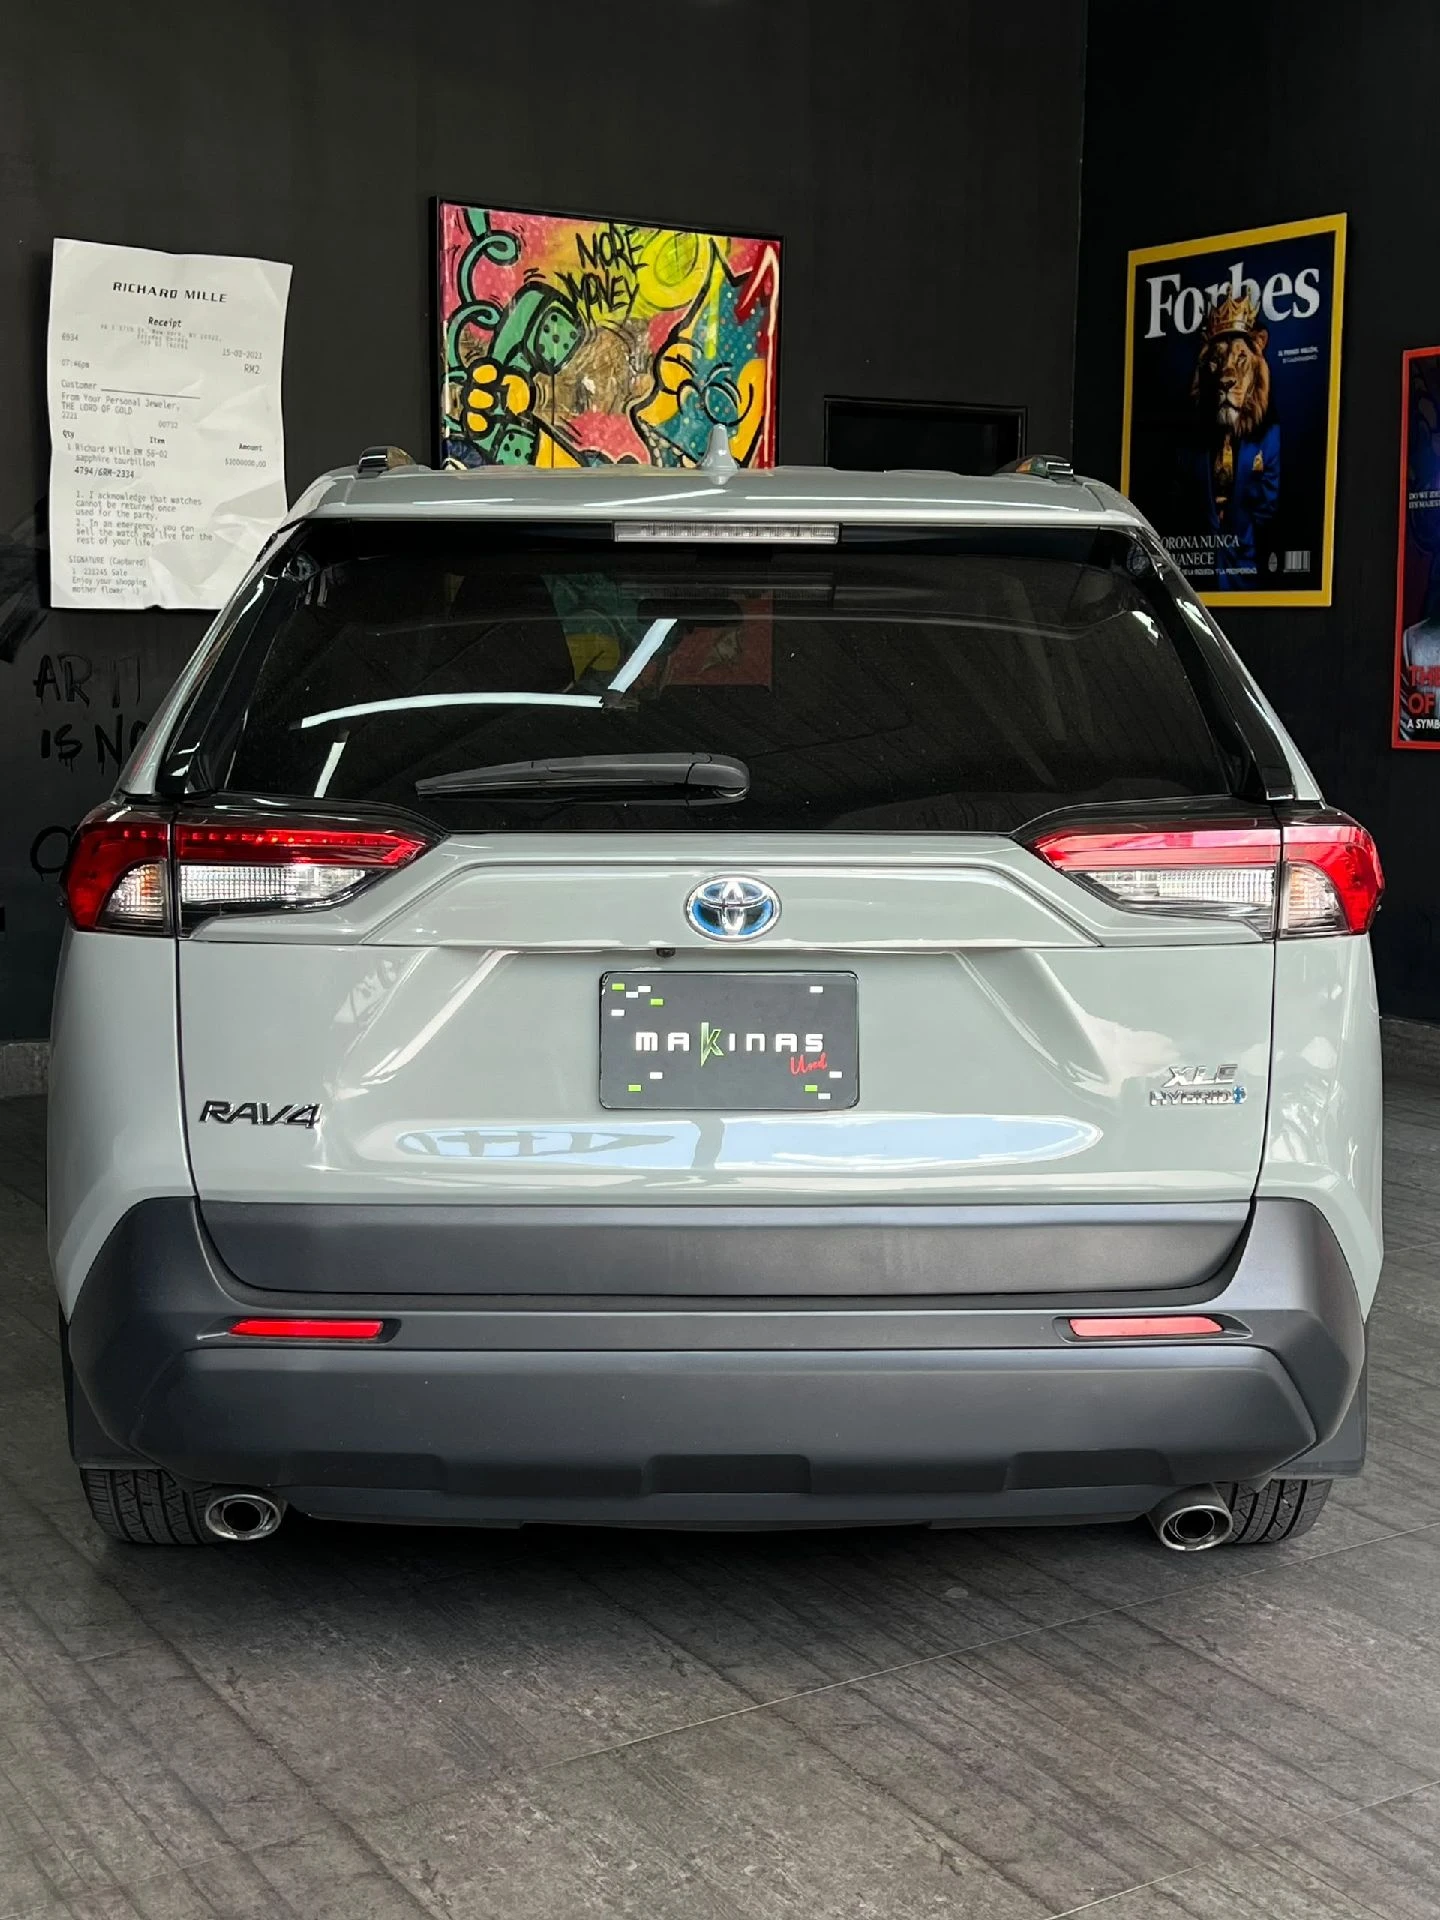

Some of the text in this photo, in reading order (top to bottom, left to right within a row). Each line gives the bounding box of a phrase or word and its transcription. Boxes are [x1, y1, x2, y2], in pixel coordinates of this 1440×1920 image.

[112, 281, 228, 303] RICHARD MILLE
[1144, 262, 1320, 338] Forbes
[148, 316, 183, 329] Receipt
[61, 379, 97, 390] Customer
[61, 391, 80, 401] From
[84, 394, 101, 403] Your
[106, 395, 140, 407] Personal
[61, 401, 133, 415] THE LORD OF GOLD
[149, 436, 165, 444] Item
[239, 442, 262, 451] Amount
[75, 443, 105, 453] Richard
[75, 454, 156, 467] sapphire tourbillon
[98, 492, 147, 503] acknowledge
[150, 495, 167, 503] that
[171, 496, 202, 505] watches
[76, 499, 177, 513] cannot be returned once
[76, 508, 94, 516] used
[99, 508, 111, 517] for
[117, 509, 130, 518] the
[90, 518, 98, 527] In
[103, 520, 112, 528] an
[163, 524, 176, 533] you
[181, 525, 194, 533] can
[76, 527, 213, 541] sell the watch and live for the
[76, 536, 95, 545] rest
[99, 536, 108, 545] of
[112, 538, 130, 548] your
[1161, 534, 1241, 549] ORONA NUNCA
[68, 555, 104, 564] SIGNATURE
[1171, 552, 1215, 566] VANECE
[112, 568, 128, 576] Sale
[72, 576, 147, 587] Enjoy your shopping
[101, 586, 123, 594] flower
[1408, 692, 1436, 714] OF
[1407, 719, 1414, 729] A
[40, 723, 82, 772] IS
[1162, 1063, 1238, 1088] XLE
[199, 1100, 323, 1129] RAV4
